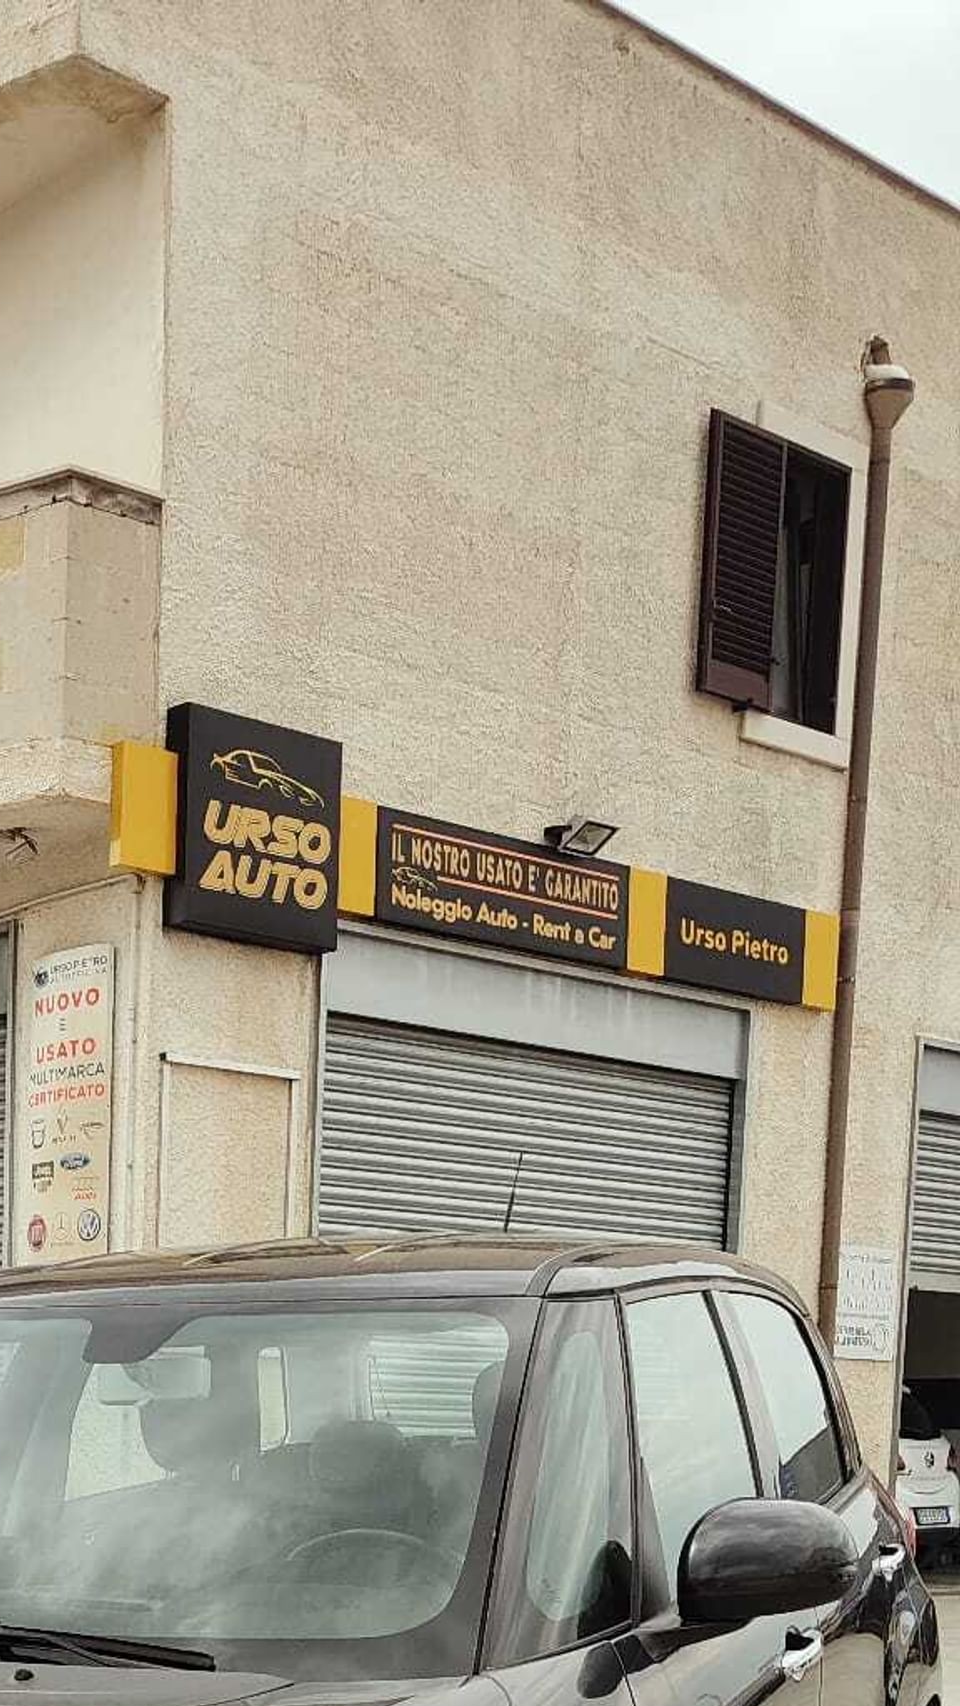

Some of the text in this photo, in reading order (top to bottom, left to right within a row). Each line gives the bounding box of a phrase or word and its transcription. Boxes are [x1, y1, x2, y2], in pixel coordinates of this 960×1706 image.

[203, 799, 331, 865] URSO
[199, 850, 328, 910] AUTO
[391, 832, 618, 911] IL NOSTRO USATO E' GARANTITO
[391, 884, 472, 923] Noleggio
[476, 901, 518, 929] Auto
[533, 913, 571, 942] Rent
[574, 930, 584, 943] a
[588, 927, 617, 950] Car
[680, 916, 789, 965] Urso Pietro
[34, 987, 100, 1018] NUOVO
[30, 1061, 105, 1086] MULTIMARCA
[36, 1037, 96, 1064] USATO
[28, 1083, 105, 1108] CERTIFICATO
